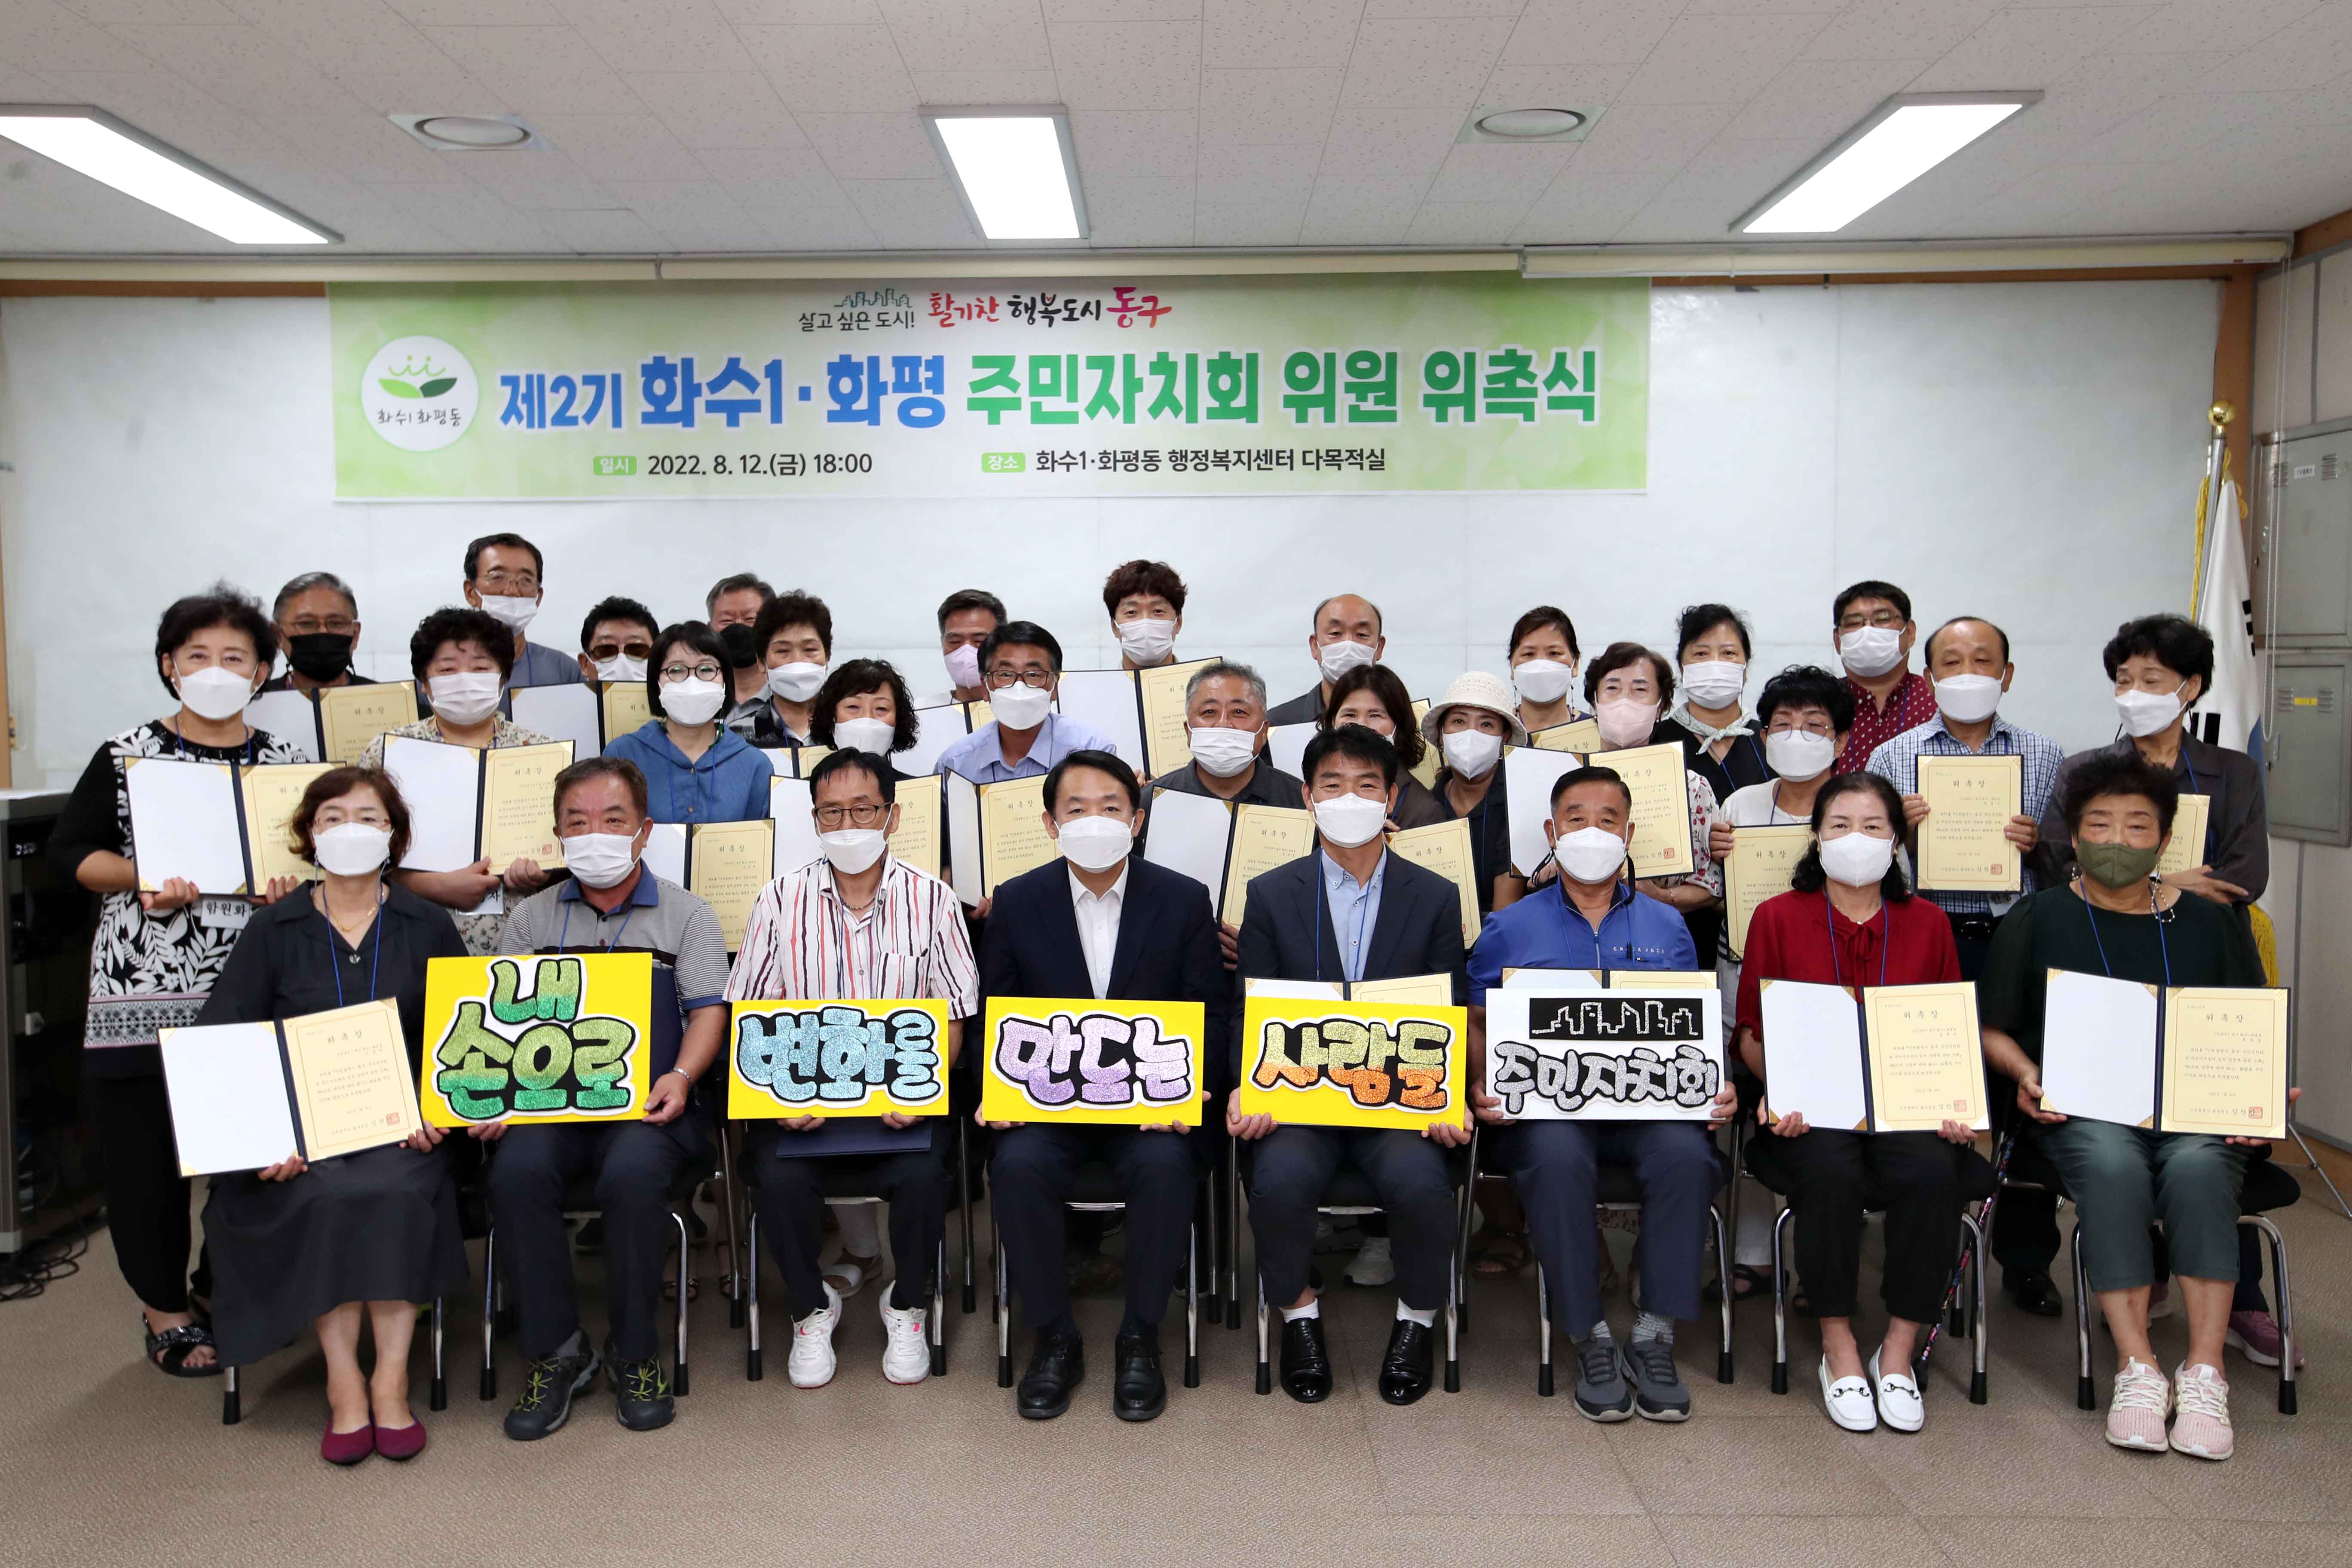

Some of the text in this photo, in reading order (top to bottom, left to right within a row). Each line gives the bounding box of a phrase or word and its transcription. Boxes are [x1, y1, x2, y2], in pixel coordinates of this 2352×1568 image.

[799, 311, 915, 332] 살고 싶은 도시!
[928, 287, 1173, 328] 활기찬 행복도시 동구
[499, 373, 622, 429] 제2기
[966, 350, 1259, 426] 주민자치회
[1283, 349, 1398, 423] 위원
[1423, 346, 1597, 425] 위촉식
[600, 457, 630, 473] 일시
[648, 455, 707, 475] 2022.
[713, 454, 733, 475] 8.
[813, 453, 873, 473] 18:00
[988, 454, 1019, 471] 장소
[1168, 448, 1294, 472] 행정복지센터
[1302, 448, 1386, 472] 다목적실
[490, 957, 582, 1025] 내
[436, 1001, 636, 1119] 손으로
[737, 1006, 940, 1102] 변화를
[995, 1014, 1192, 1106] 만드는
[1494, 1041, 1719, 1114] 주민자치회
